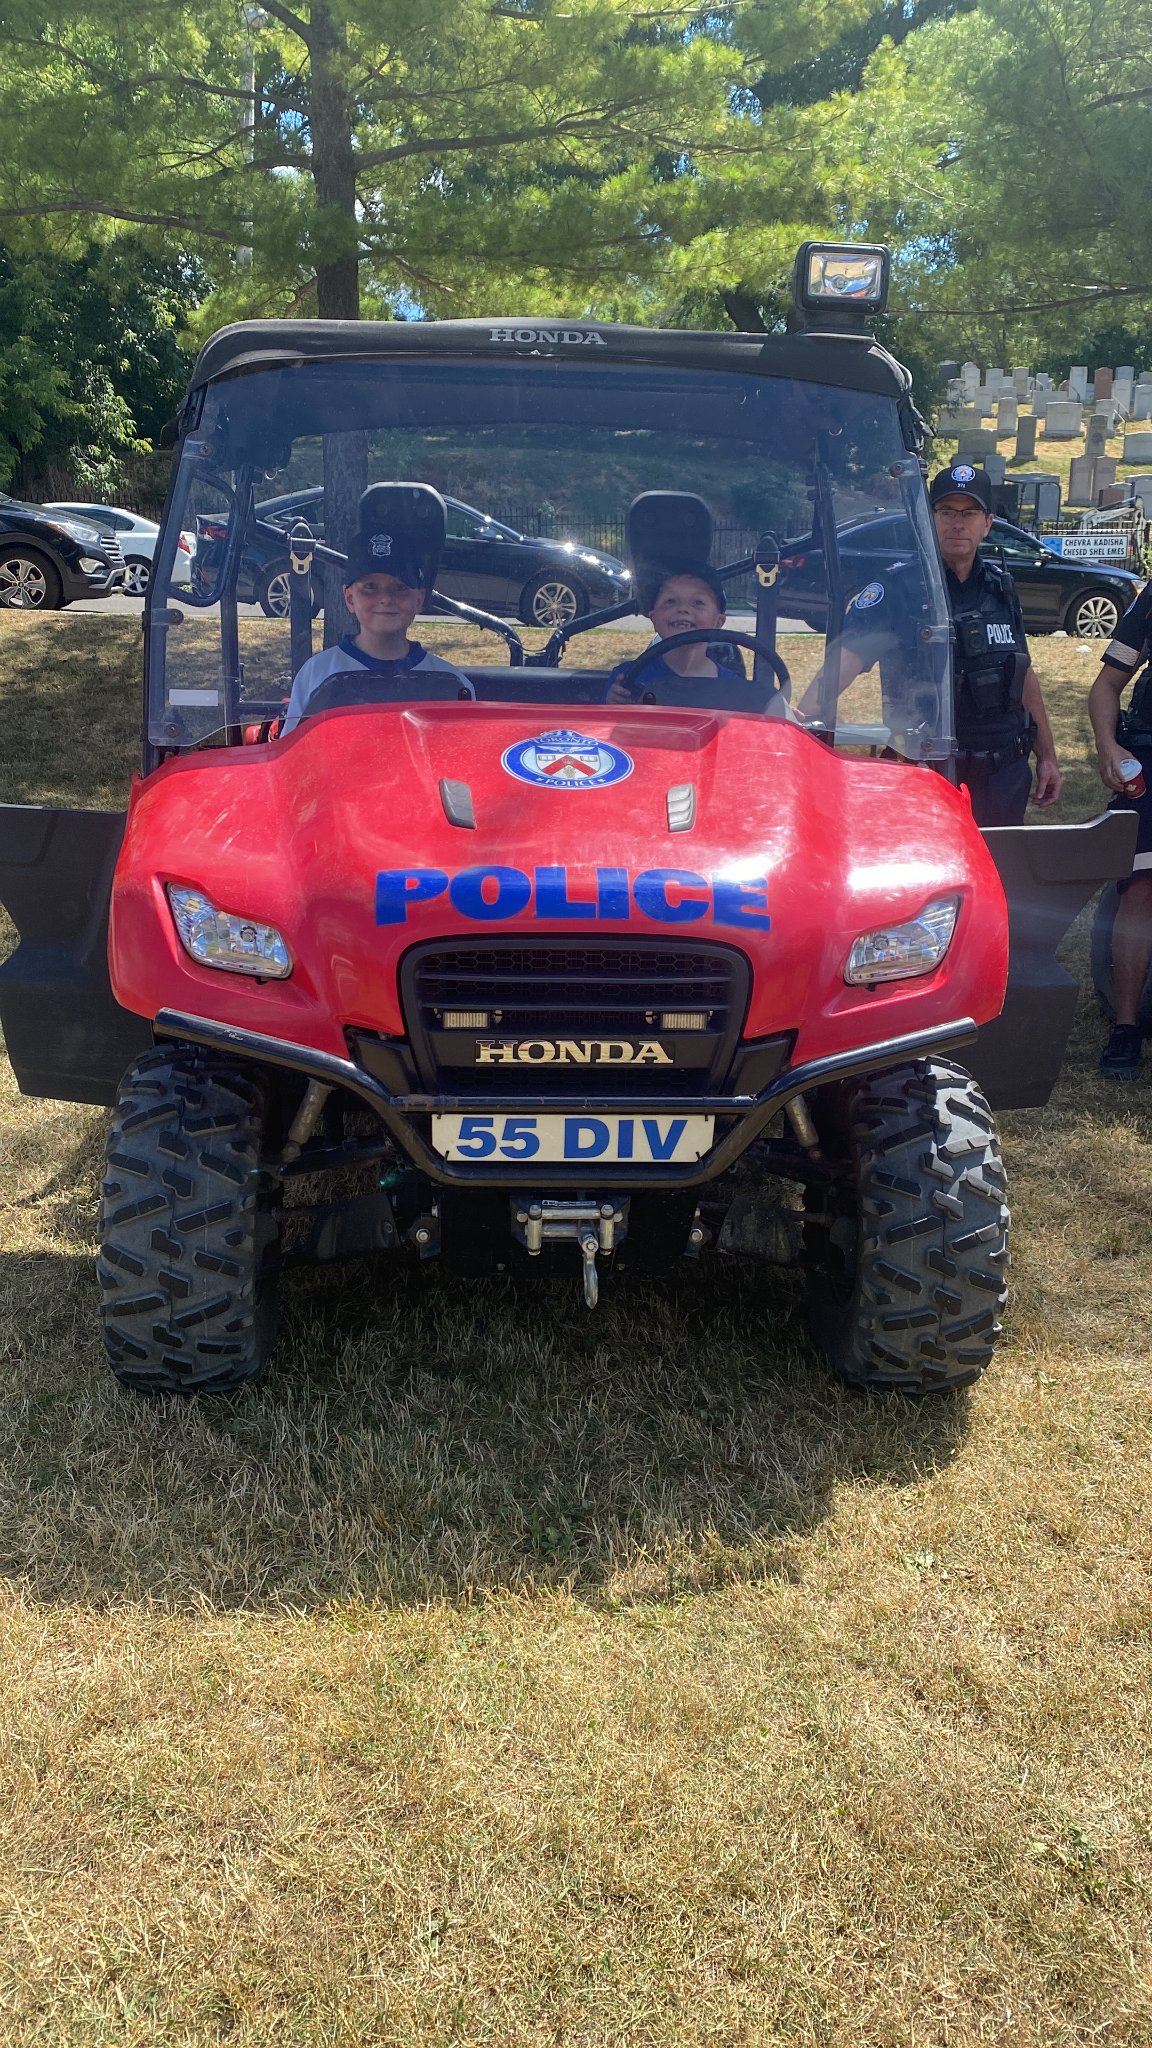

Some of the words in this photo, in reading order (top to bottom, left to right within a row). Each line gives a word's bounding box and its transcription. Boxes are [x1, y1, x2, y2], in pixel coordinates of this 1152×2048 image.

[489, 328, 608, 345] HONDA
[1064, 538, 1092, 547] CHEVRA
[1093, 538, 1124, 546] KADISHA
[1063, 548, 1088, 556] CHESED
[1089, 548, 1105, 556] SHEL
[1107, 547, 1125, 555] EMES
[986, 623, 1016, 645] POLICE
[533, 736, 599, 745] TORONTO
[545, 778, 597, 787] POLICE
[375, 865, 771, 931] POLICE
[475, 1039, 675, 1064] HONDA
[456, 1117, 540, 1160] 55
[563, 1118, 688, 1160] DIV
